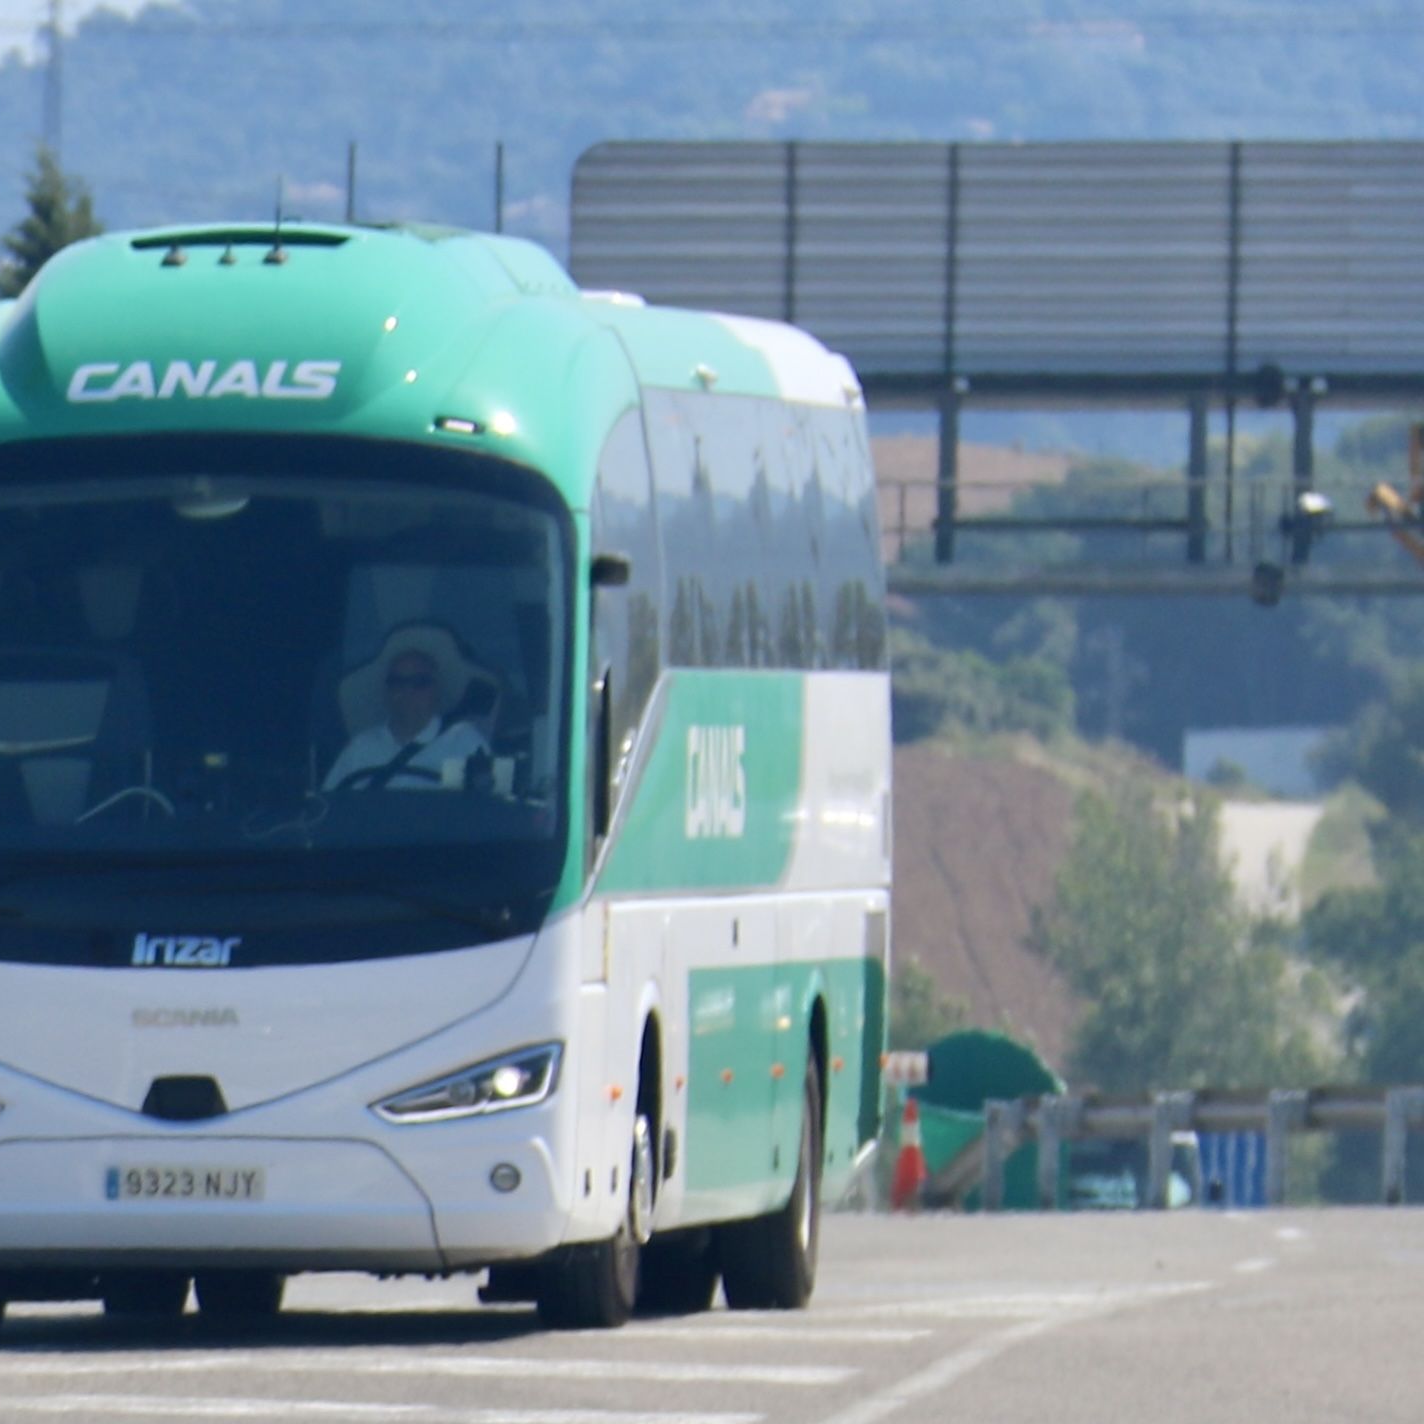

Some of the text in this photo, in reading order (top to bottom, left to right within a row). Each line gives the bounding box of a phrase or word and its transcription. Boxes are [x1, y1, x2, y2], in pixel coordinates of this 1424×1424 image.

[67, 360, 342, 402] CANALS
[126, 1168, 257, 1199] 9323 NJY
